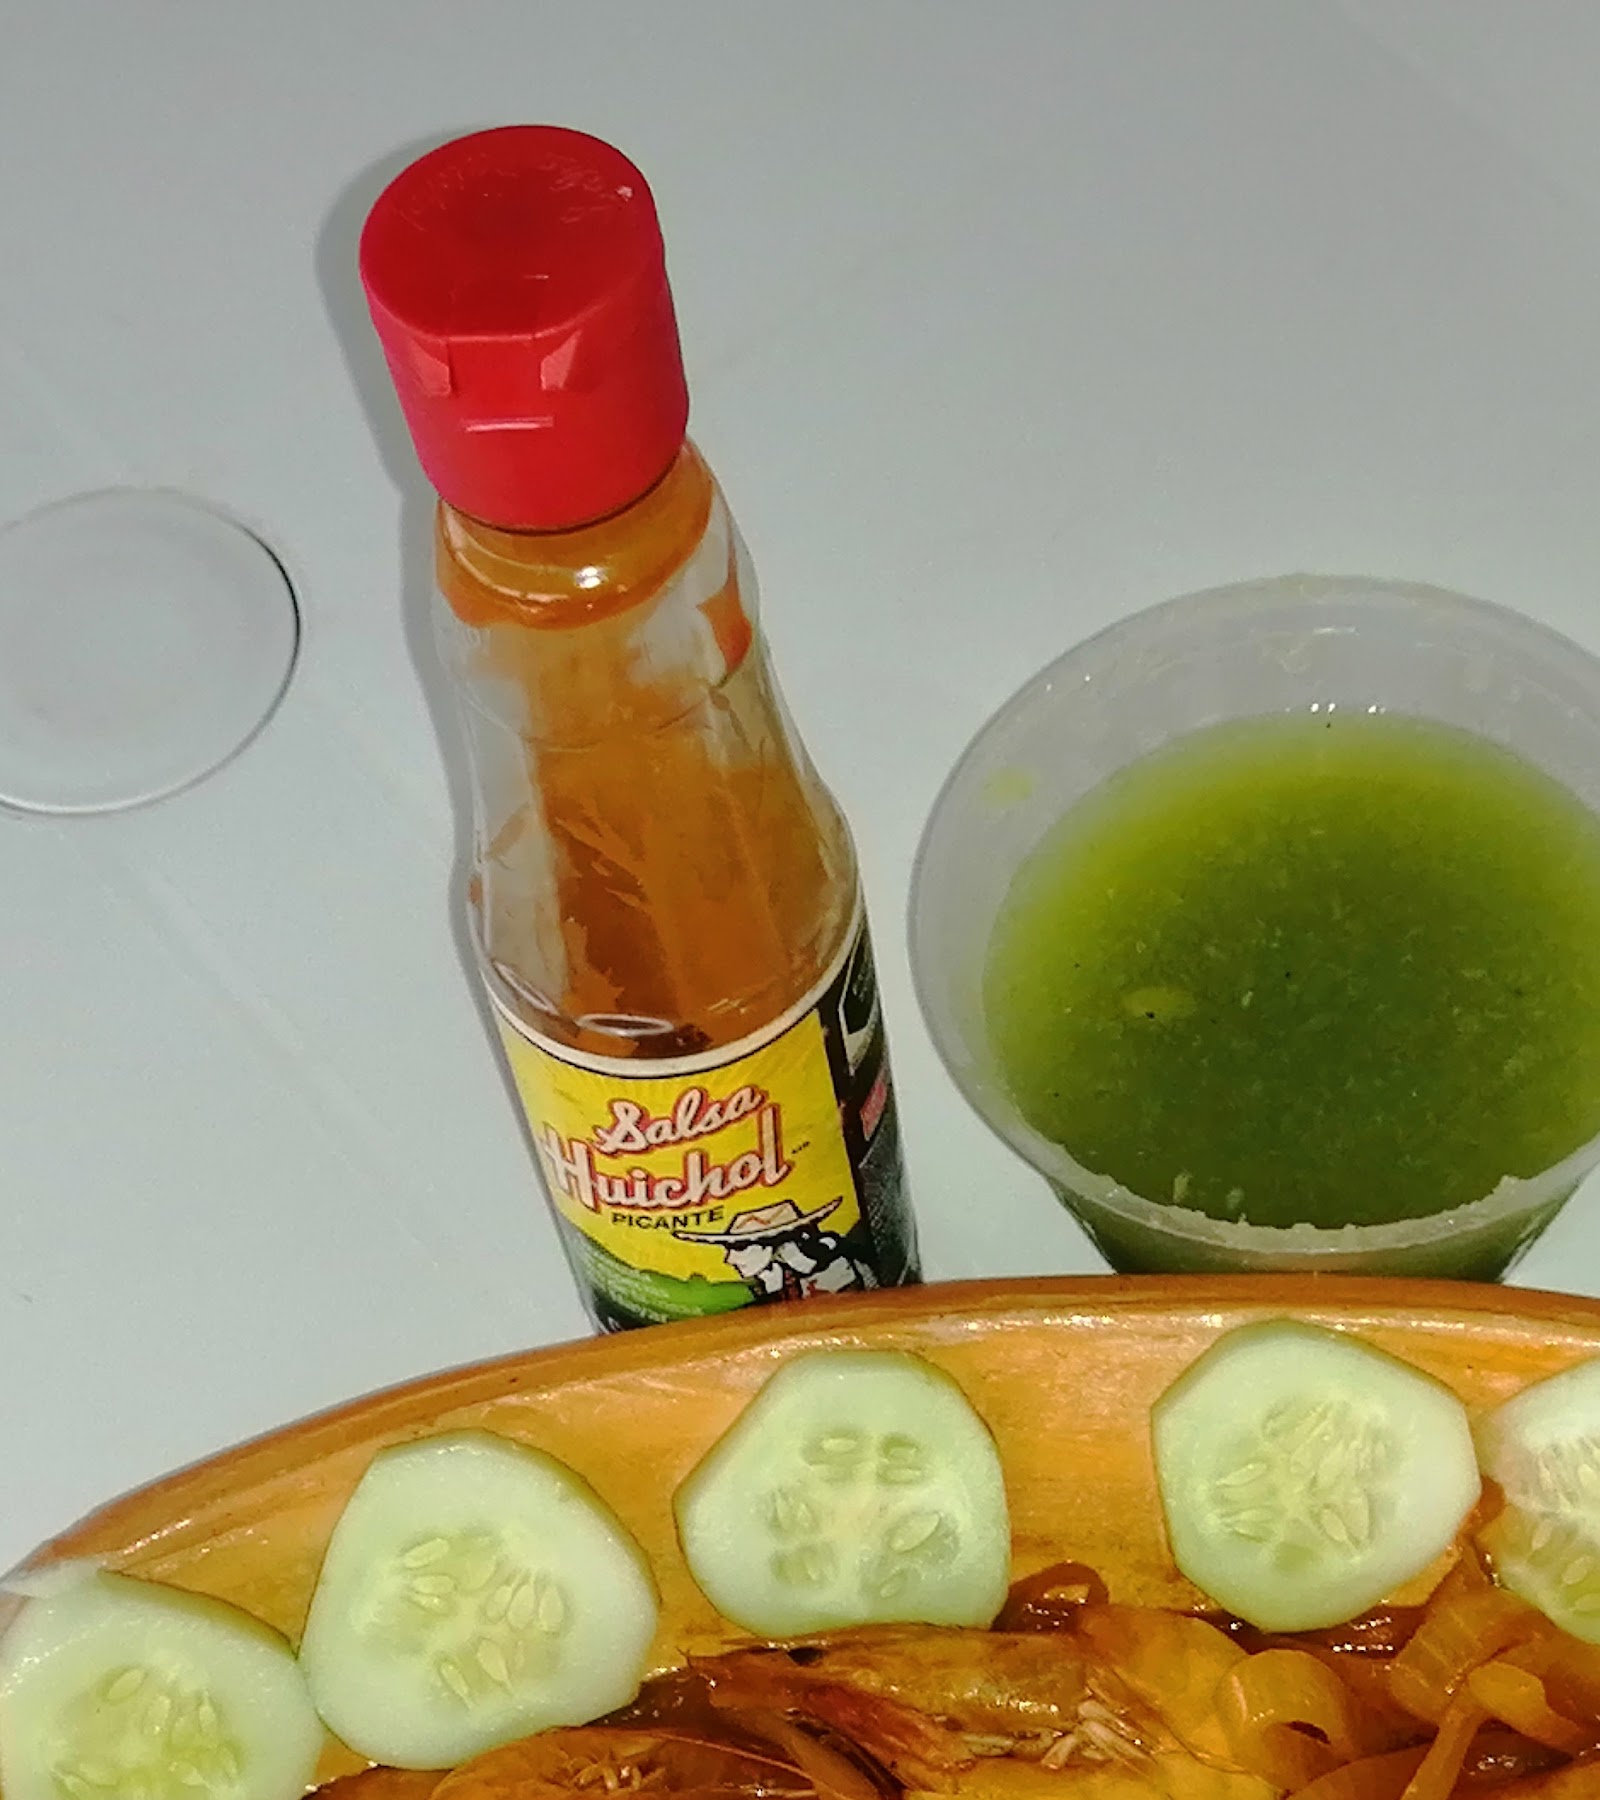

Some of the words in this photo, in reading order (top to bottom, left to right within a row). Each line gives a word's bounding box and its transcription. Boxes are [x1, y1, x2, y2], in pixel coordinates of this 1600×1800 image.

[591, 1084, 769, 1156] Salsa
[538, 1102, 794, 1214] Huichol
[611, 1205, 725, 1232] PICANTE
